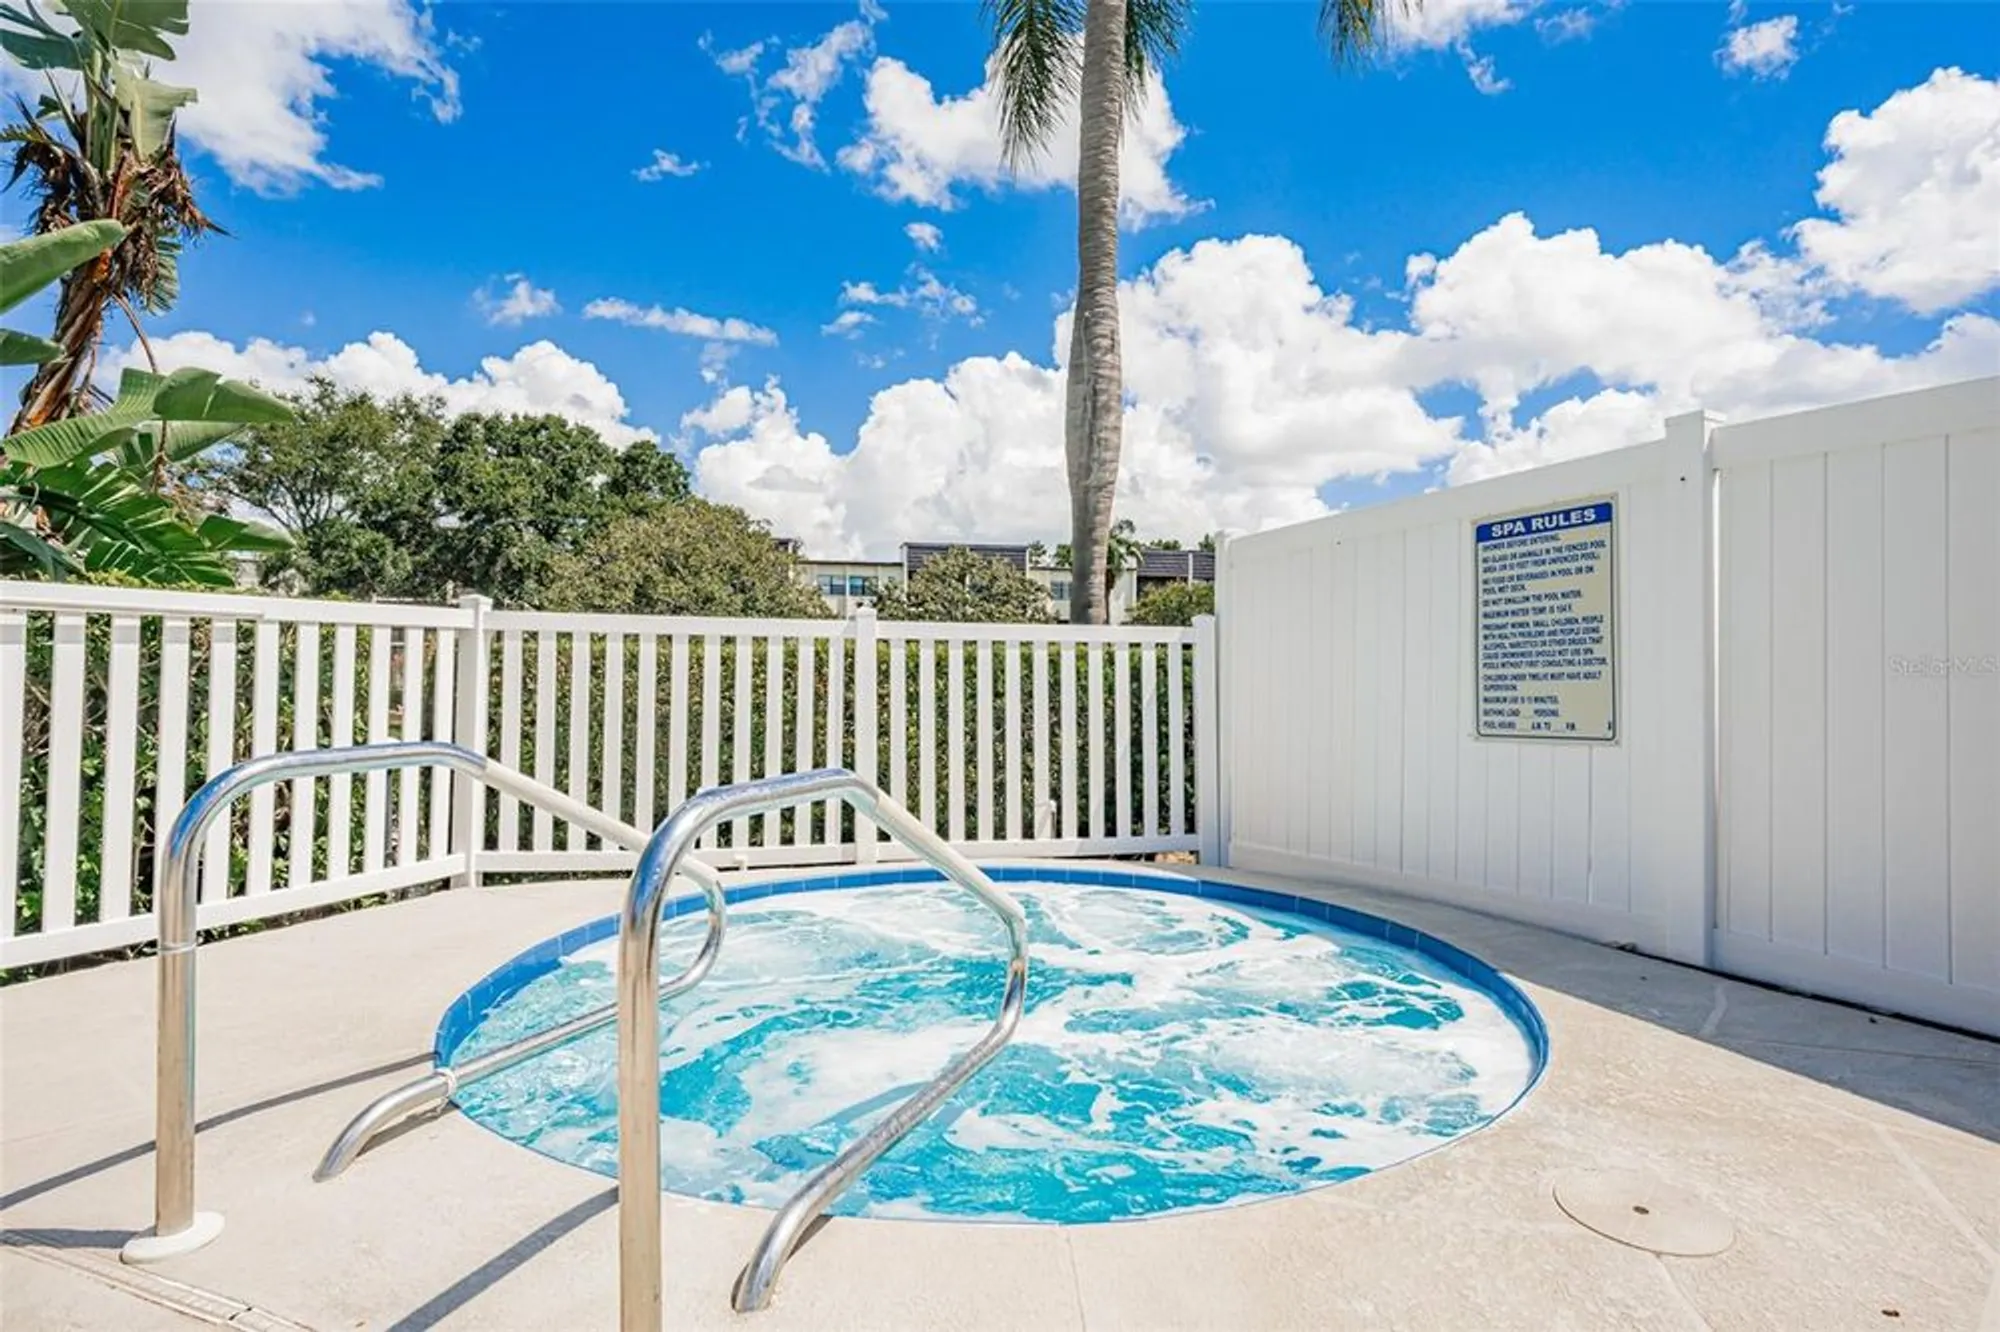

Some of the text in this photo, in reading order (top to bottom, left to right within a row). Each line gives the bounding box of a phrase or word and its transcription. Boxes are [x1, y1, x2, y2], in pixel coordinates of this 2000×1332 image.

[1492, 508, 1596, 537] SPA RULES
[1532, 593, 1542, 601] THE
[1544, 592, 1559, 601] POOL
